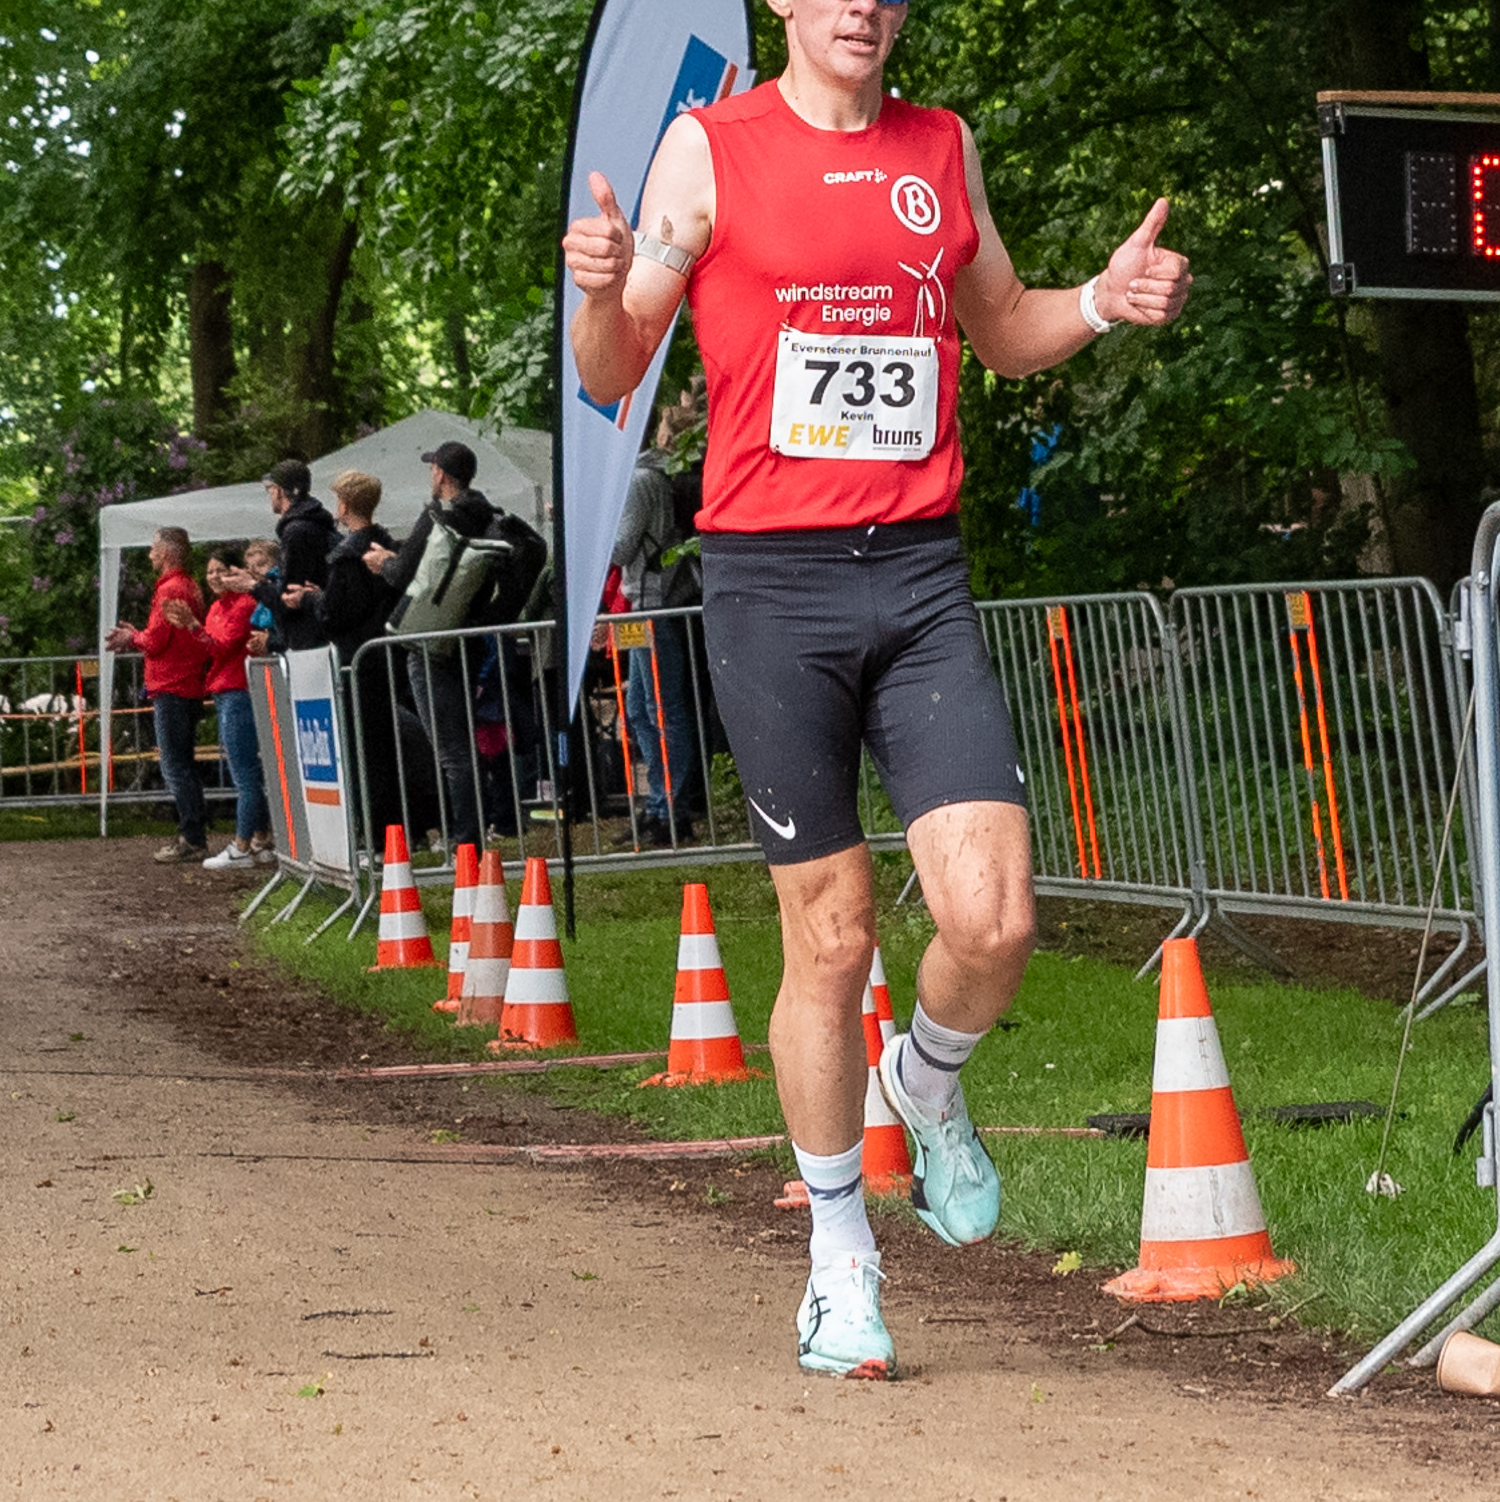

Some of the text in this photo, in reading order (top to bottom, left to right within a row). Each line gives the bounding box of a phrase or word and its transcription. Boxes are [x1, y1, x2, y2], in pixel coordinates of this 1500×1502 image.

[823, 170, 874, 185] CRAFT
[774, 282, 893, 303] windstream
[821, 303, 891, 327] Energie
[791, 342, 932, 357] Everstener Brunnenlauf
[804, 359, 916, 408] 733
[840, 410, 874, 421] Kevin
[788, 422, 923, 447] EWE bruns
